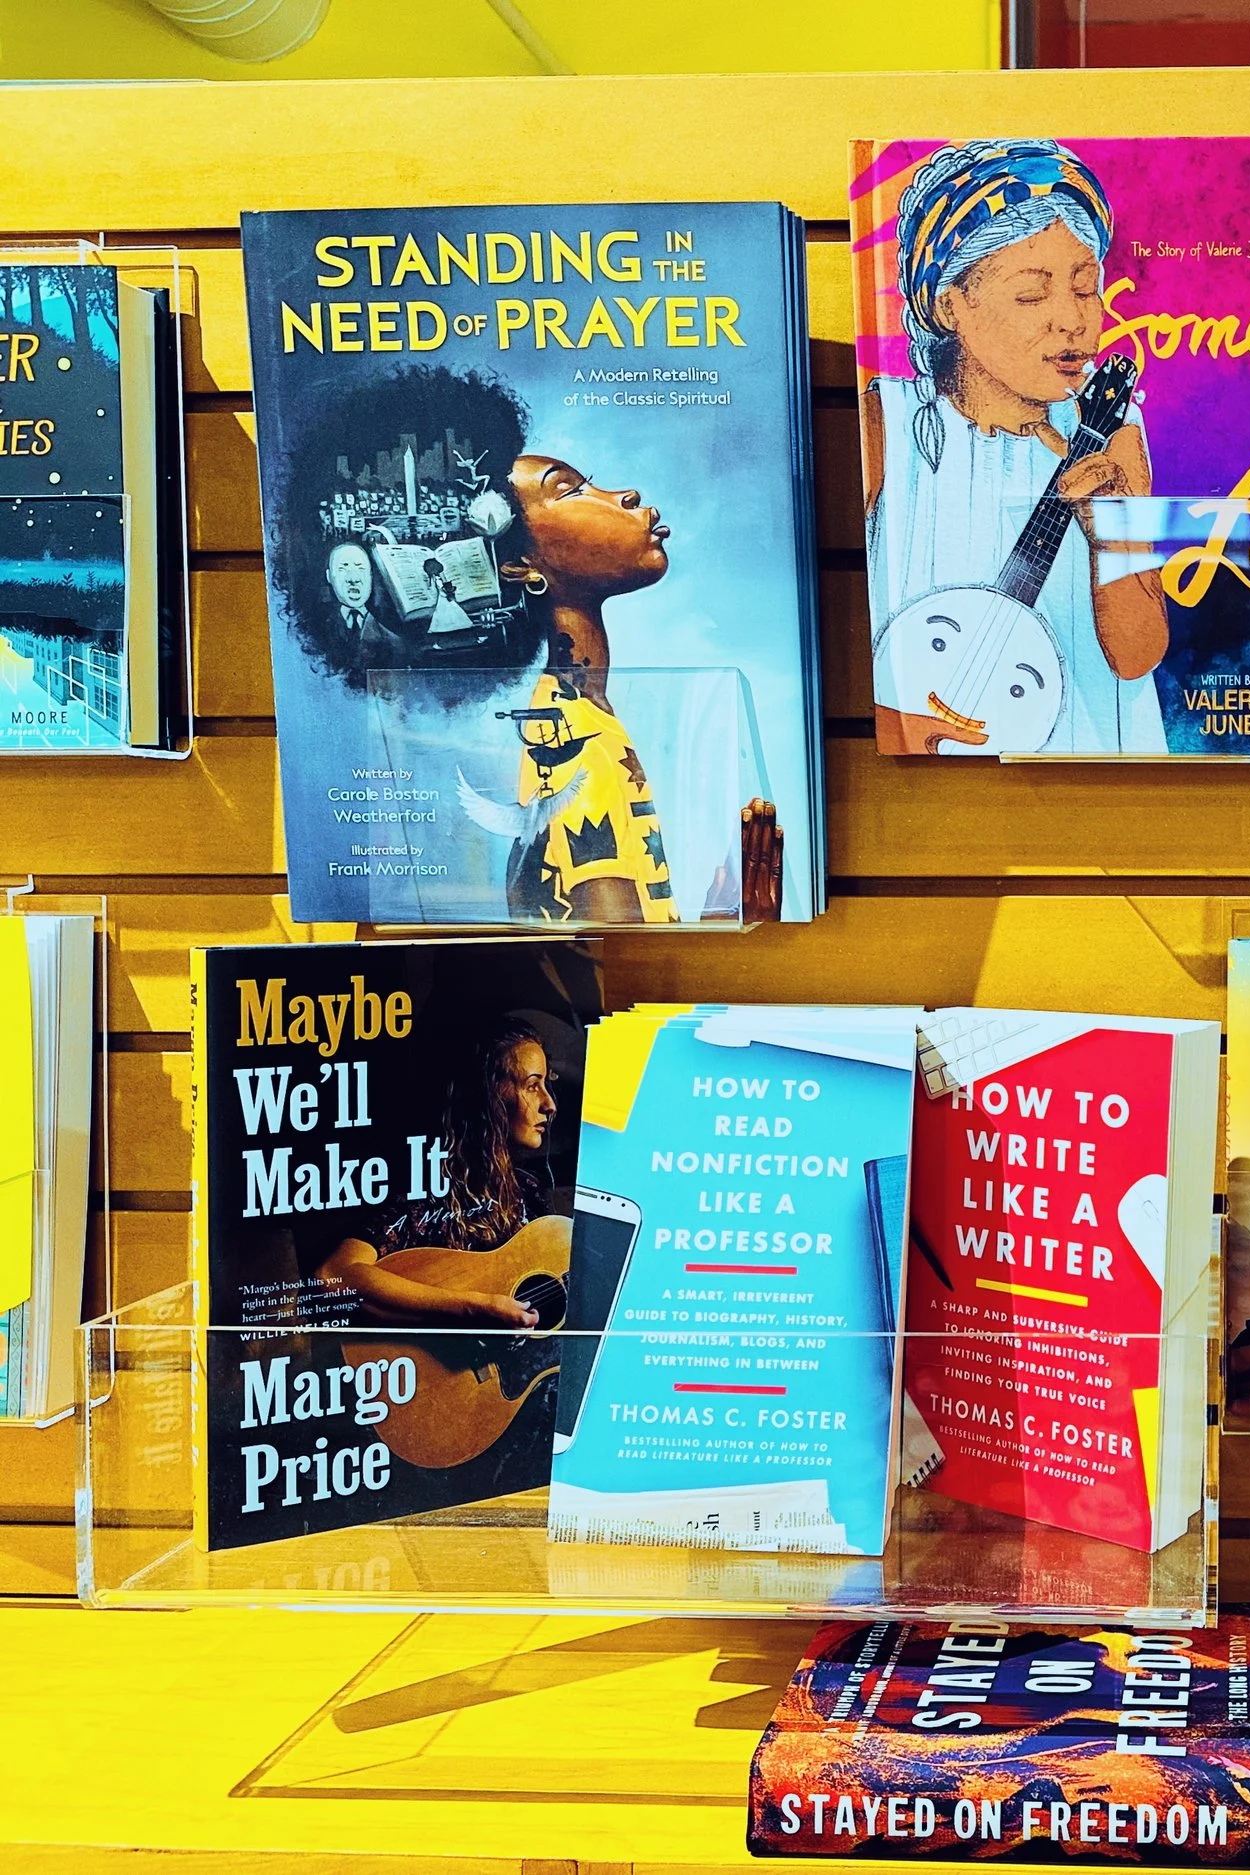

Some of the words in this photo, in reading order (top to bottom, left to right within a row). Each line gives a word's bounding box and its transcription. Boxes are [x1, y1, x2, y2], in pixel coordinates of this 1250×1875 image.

[314, 230, 642, 287] STANDING
[665, 231, 692, 253] IN
[1131, 241, 1152, 257] The
[1157, 241, 1185, 262] Story
[1190, 241, 1203, 261] of
[1206, 240, 1242, 257] Valerie
[653, 260, 706, 282] THE
[281, 300, 448, 355] NEED
[453, 314, 487, 337] OF
[496, 295, 748, 350] PRAYER
[574, 368, 585, 382] A
[588, 367, 649, 383] Modern
[652, 367, 719, 386] Retelling
[563, 391, 580, 406] of
[583, 391, 609, 406] the
[612, 390, 665, 406] Classic
[668, 390, 731, 408] Spiritual
[11, 711, 68, 724] MOORE
[327, 787, 379, 802] Carole
[383, 787, 439, 801] Boston
[333, 809, 436, 823] Weatherford
[352, 844, 408, 856] Illustrated
[410, 845, 424, 857] by
[329, 862, 371, 876] Frank
[376, 862, 448, 876] Morrison
[235, 975, 413, 1058] Maybe
[233, 1061, 372, 1136] We'll
[692, 1076, 770, 1100] HOW
[782, 1079, 821, 1101] TO
[951, 1081, 1053, 1120] HOW
[1074, 1090, 1130, 1129] TO
[714, 1115, 793, 1138] READ
[651, 1151, 849, 1178] NONFICTION
[966, 1128, 1096, 1176] WRITE
[242, 1143, 389, 1218] Make
[406, 1134, 450, 1201] It
[698, 1191, 762, 1214] LIKE
[774, 1193, 795, 1214] A
[963, 1177, 1049, 1220] LIKE
[1072, 1193, 1098, 1227] A
[654, 1228, 833, 1255] PROFESSOR
[955, 1224, 1114, 1281] WRITER
[282, 1279, 305, 1290] book
[307, 1278, 324, 1287] hits
[326, 1276, 342, 1288] you
[662, 1289, 672, 1300] A
[677, 1289, 727, 1303] SMART,
[733, 1291, 815, 1304] IRREVERENT
[624, 1309, 667, 1322] GUIDE
[672, 1310, 690, 1322] TO
[694, 1311, 780, 1326] BIOGRAPHY,
[785, 1314, 848, 1328] HISTORY,
[640, 1333, 734, 1348] JOURNALISM,
[740, 1336, 790, 1350] BLOGS,
[796, 1338, 826, 1350] AND
[644, 1354, 730, 1369] EVERYTHING
[735, 1356, 752, 1369] IN
[756, 1358, 819, 1371] BETWEEN
[940, 1345, 993, 1364] INVITING
[998, 1356, 1080, 1384] INSPIRATION,
[1085, 1375, 1113, 1390] AND
[240, 1356, 417, 1429] Margo
[944, 1367, 993, 1386] FINDING
[998, 1378, 1029, 1394] YOUR
[1035, 1385, 1064, 1401] TRUE
[1069, 1393, 1106, 1411] VOICE
[609, 1404, 715, 1426] THOMAS
[725, 1408, 747, 1428] C.
[757, 1409, 848, 1431] FOSTER
[930, 1393, 1015, 1431] THOMAS
[1023, 1415, 1044, 1438] C.
[1051, 1421, 1133, 1459] FOSTER
[241, 1437, 391, 1513] Price
[1229, 1634, 1248, 1673] HISTORY
[911, 1622, 1011, 1729] STAYED
[1024, 1660, 1096, 1693] ON
[1228, 1675, 1248, 1699] LONG
[1228, 1701, 1248, 1721] THE
[780, 1793, 936, 1838] STAYED
[954, 1798, 1000, 1841] ON
[1022, 1801, 1228, 1847] FREEDOM
